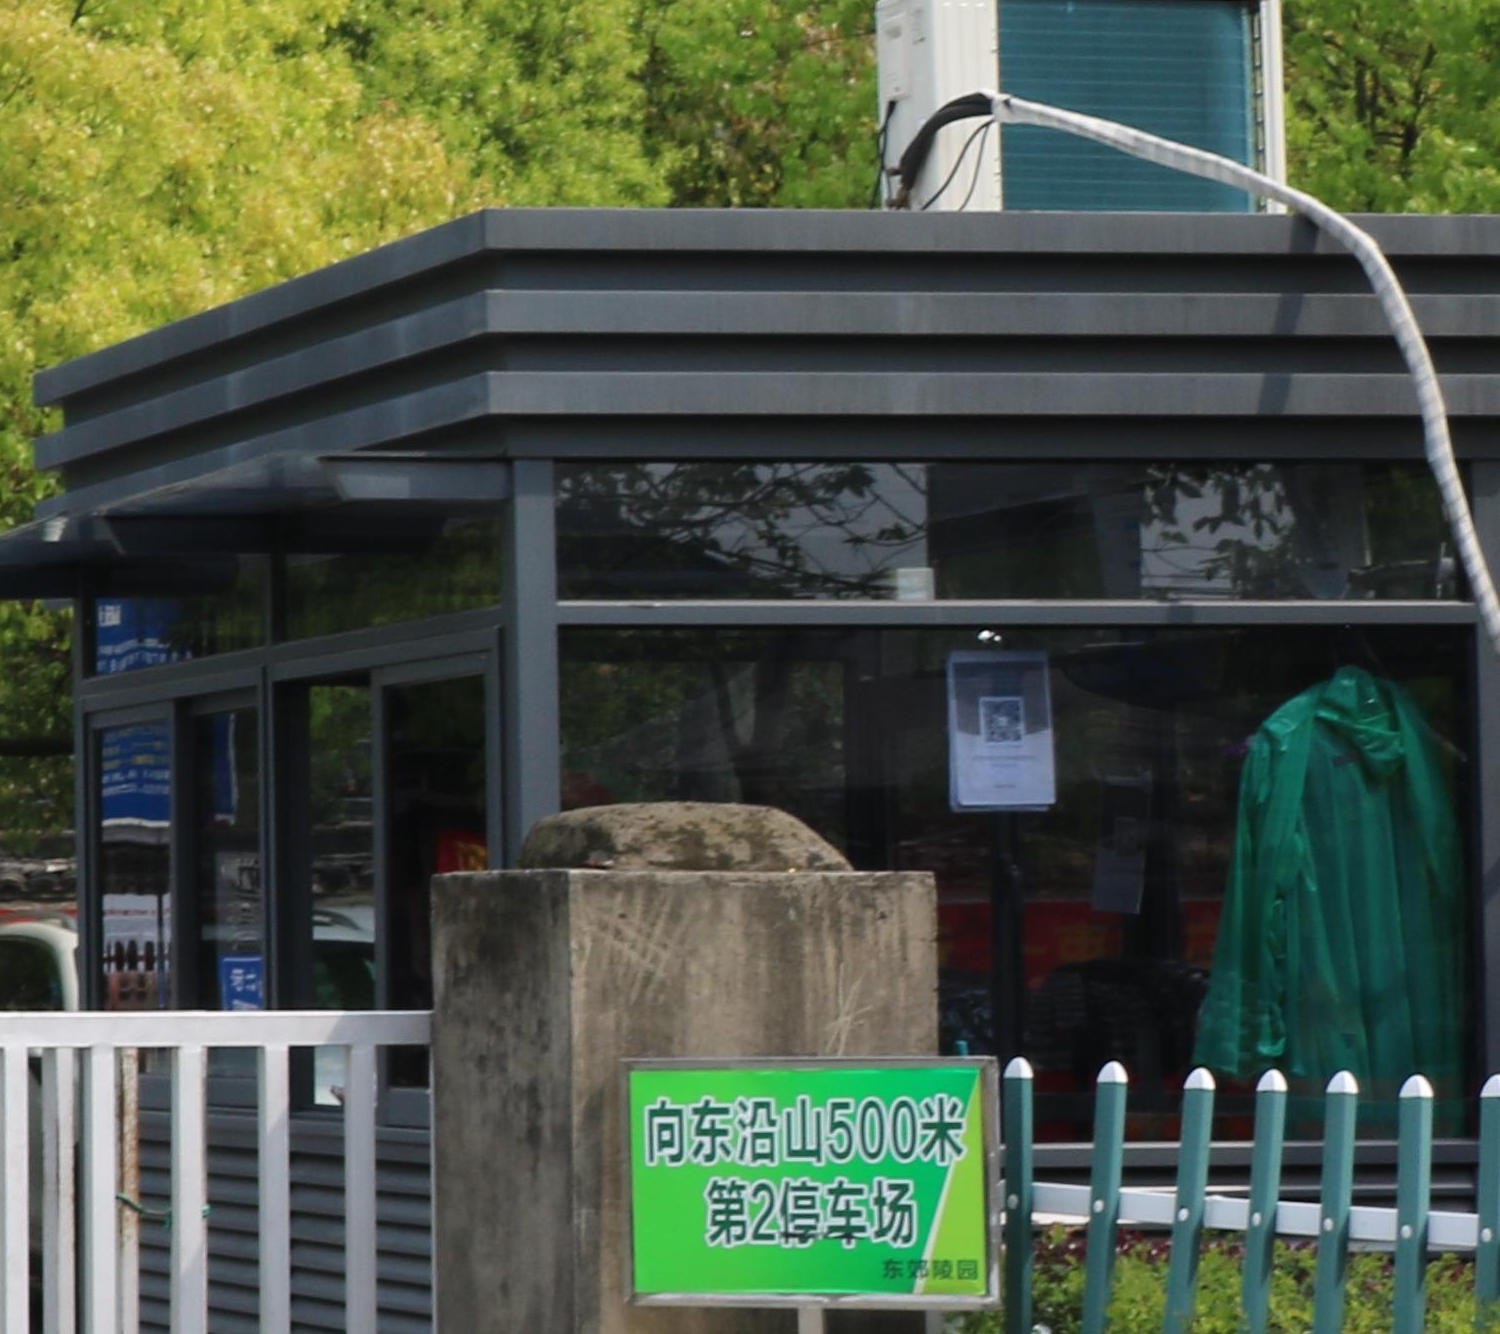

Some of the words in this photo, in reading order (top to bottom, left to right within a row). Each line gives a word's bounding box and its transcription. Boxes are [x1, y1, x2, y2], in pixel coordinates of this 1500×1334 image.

[644, 1093, 967, 1166] 向东沿山500米
[703, 1176, 919, 1249] 第2停车场
[882, 1259, 979, 1281] 东郊陵园
